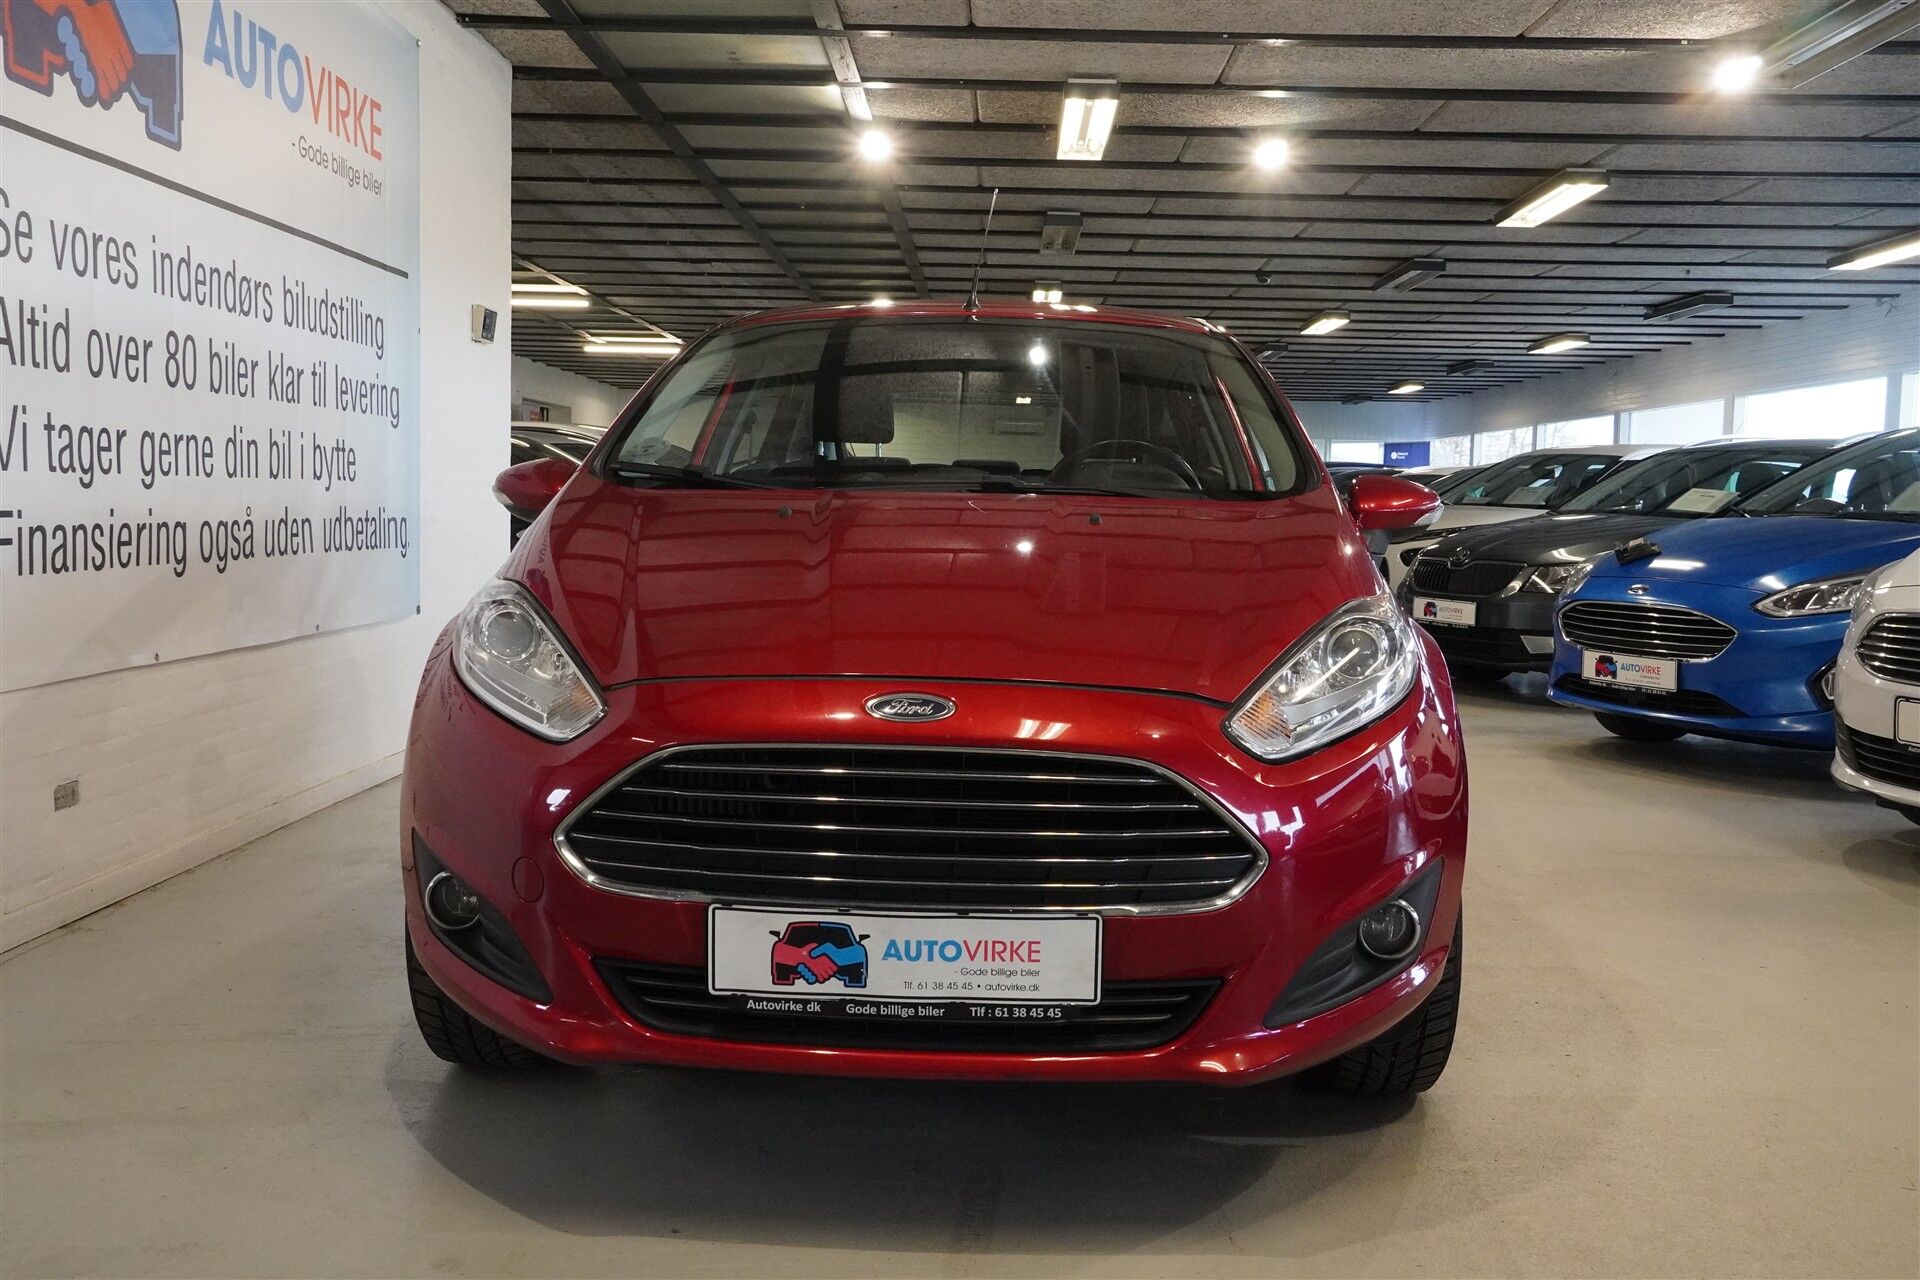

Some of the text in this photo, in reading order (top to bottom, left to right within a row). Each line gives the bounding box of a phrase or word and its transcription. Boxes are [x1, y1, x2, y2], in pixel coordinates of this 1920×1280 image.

[203, 0, 382, 160] AUTOVIRKE
[299, 136, 329, 169] Gode
[332, 152, 360, 188] billige
[363, 168, 382, 196] biler
[50, 219, 139, 290] vores
[152, 235, 273, 322] indendørs
[283, 275, 384, 359] biludstilling
[0, 296, 400, 429] Altid over 80 biler klar til levering
[0, 405, 356, 491] Vi tager gerne din bil i bytte
[200, 506, 255, 574] også
[264, 506, 314, 557] uden
[323, 506, 410, 559] udbetaling.
[1620, 663, 1662, 675] AUTOVIRKE
[883, 698, 934, 714] Ford
[882, 939, 1041, 963] AUTOVIRKE
[904, 981, 1040, 992] Tlf. 61 38 45 45 autovirke.dk
[960, 967, 988, 977] Gode
[990, 967, 1018, 978] billige
[1020, 968, 1040, 977] biler
[747, 1000, 803, 1013] Autovirke
[806, 1001, 821, 1012] dk
[846, 1003, 877, 1015] Gode
[880, 1004, 915, 1017] billige
[918, 1006, 945, 1017] biler
[970, 1007, 986, 1017] Tlf
[994, 1008, 1009, 1018] 61
[1012, 1008, 1026, 1018] 38
[1029, 1008, 1044, 1018] 45
[1047, 1008, 1062, 1019] 45
